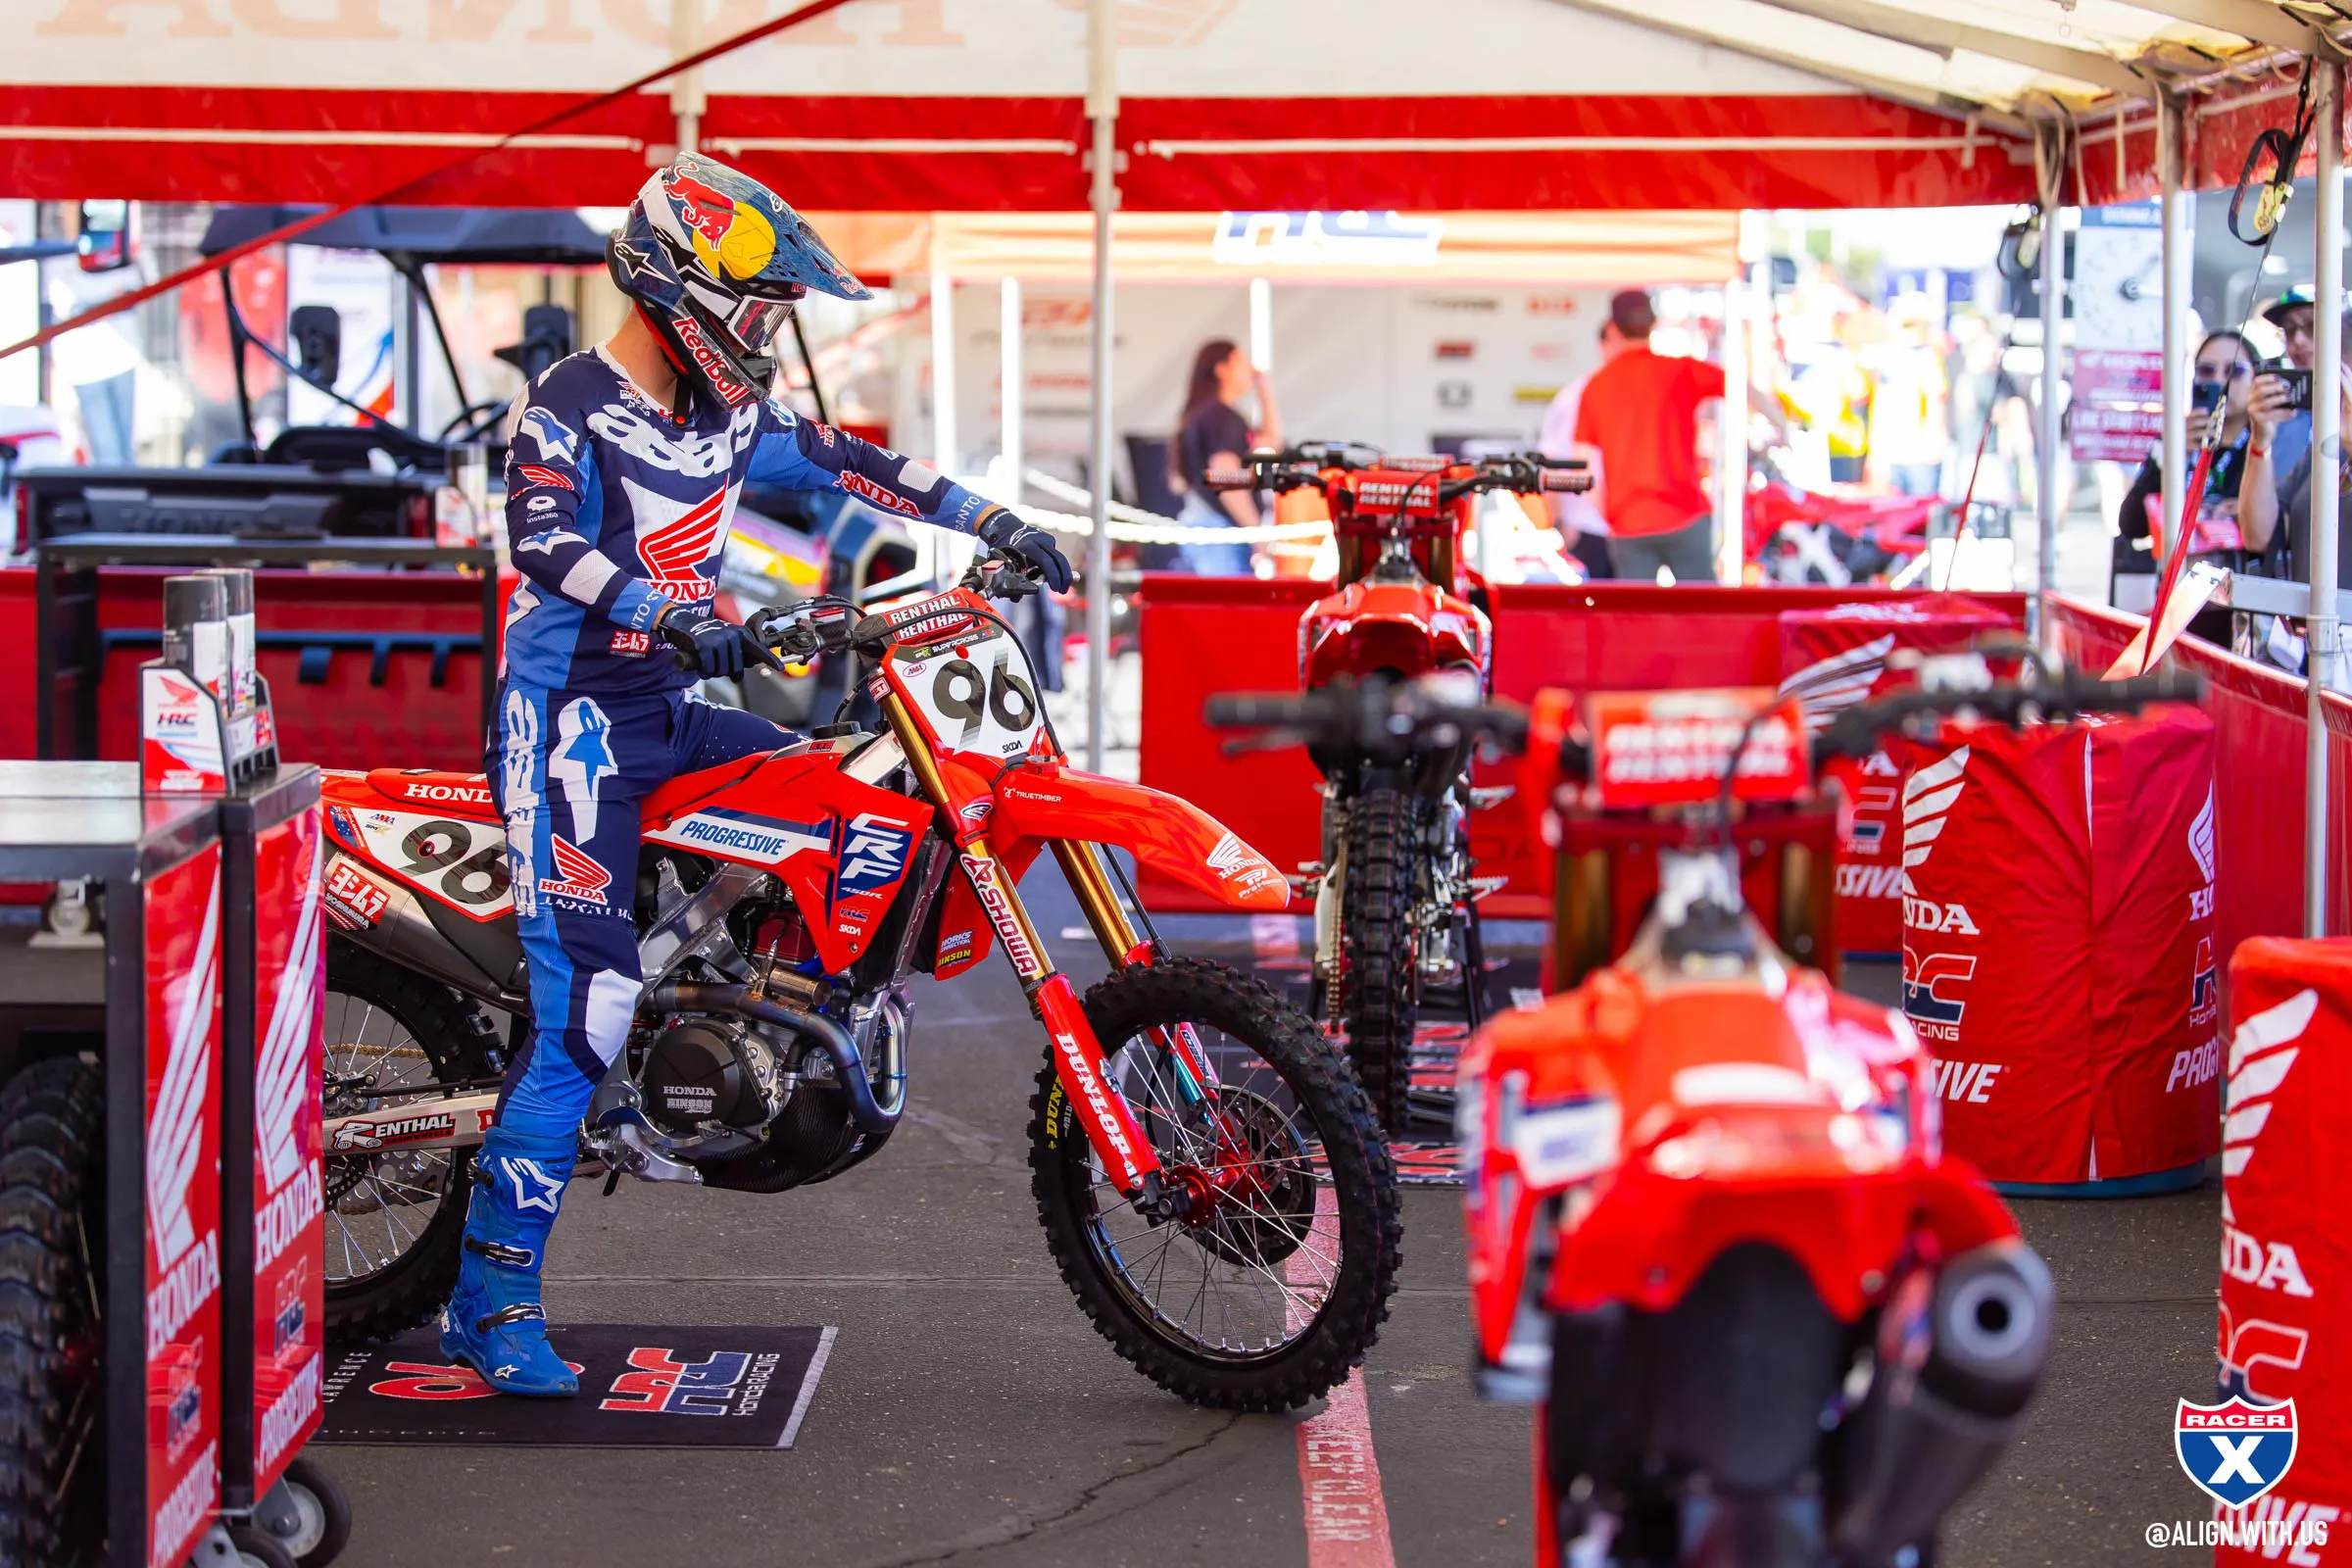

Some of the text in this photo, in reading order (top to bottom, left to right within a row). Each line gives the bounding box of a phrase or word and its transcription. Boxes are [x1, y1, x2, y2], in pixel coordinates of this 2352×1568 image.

[672, 317, 723, 367] Red
[526, 513, 559, 524] Insta360
[890, 595, 959, 625] RENTHAL
[899, 612, 968, 640] RENTHAL
[933, 648, 1036, 749] 96
[157, 712, 198, 725] HRC
[1016, 791, 1062, 803] TRUETIMBER
[368, 812, 396, 825] AMA
[679, 820, 786, 857] PROGRESSIVE
[840, 812, 909, 879] CRF
[401, 819, 510, 906] 96
[1218, 858, 1264, 879] HONDA
[327, 866, 388, 917] ヨシムラ
[540, 880, 606, 903] HONDA
[840, 886, 884, 901] 450R
[838, 924, 861, 937] SKDA
[981, 888, 1039, 976] SHOWA
[662, 1086, 717, 1097] HONDA
[1055, 1033, 1131, 1155] DUNLOP
[255, 1157, 323, 1274] HONDA
[147, 1229, 221, 1362] HONDA
[599, 1347, 754, 1415] HRC
[1310, 1478, 1372, 1542] CLEAR
